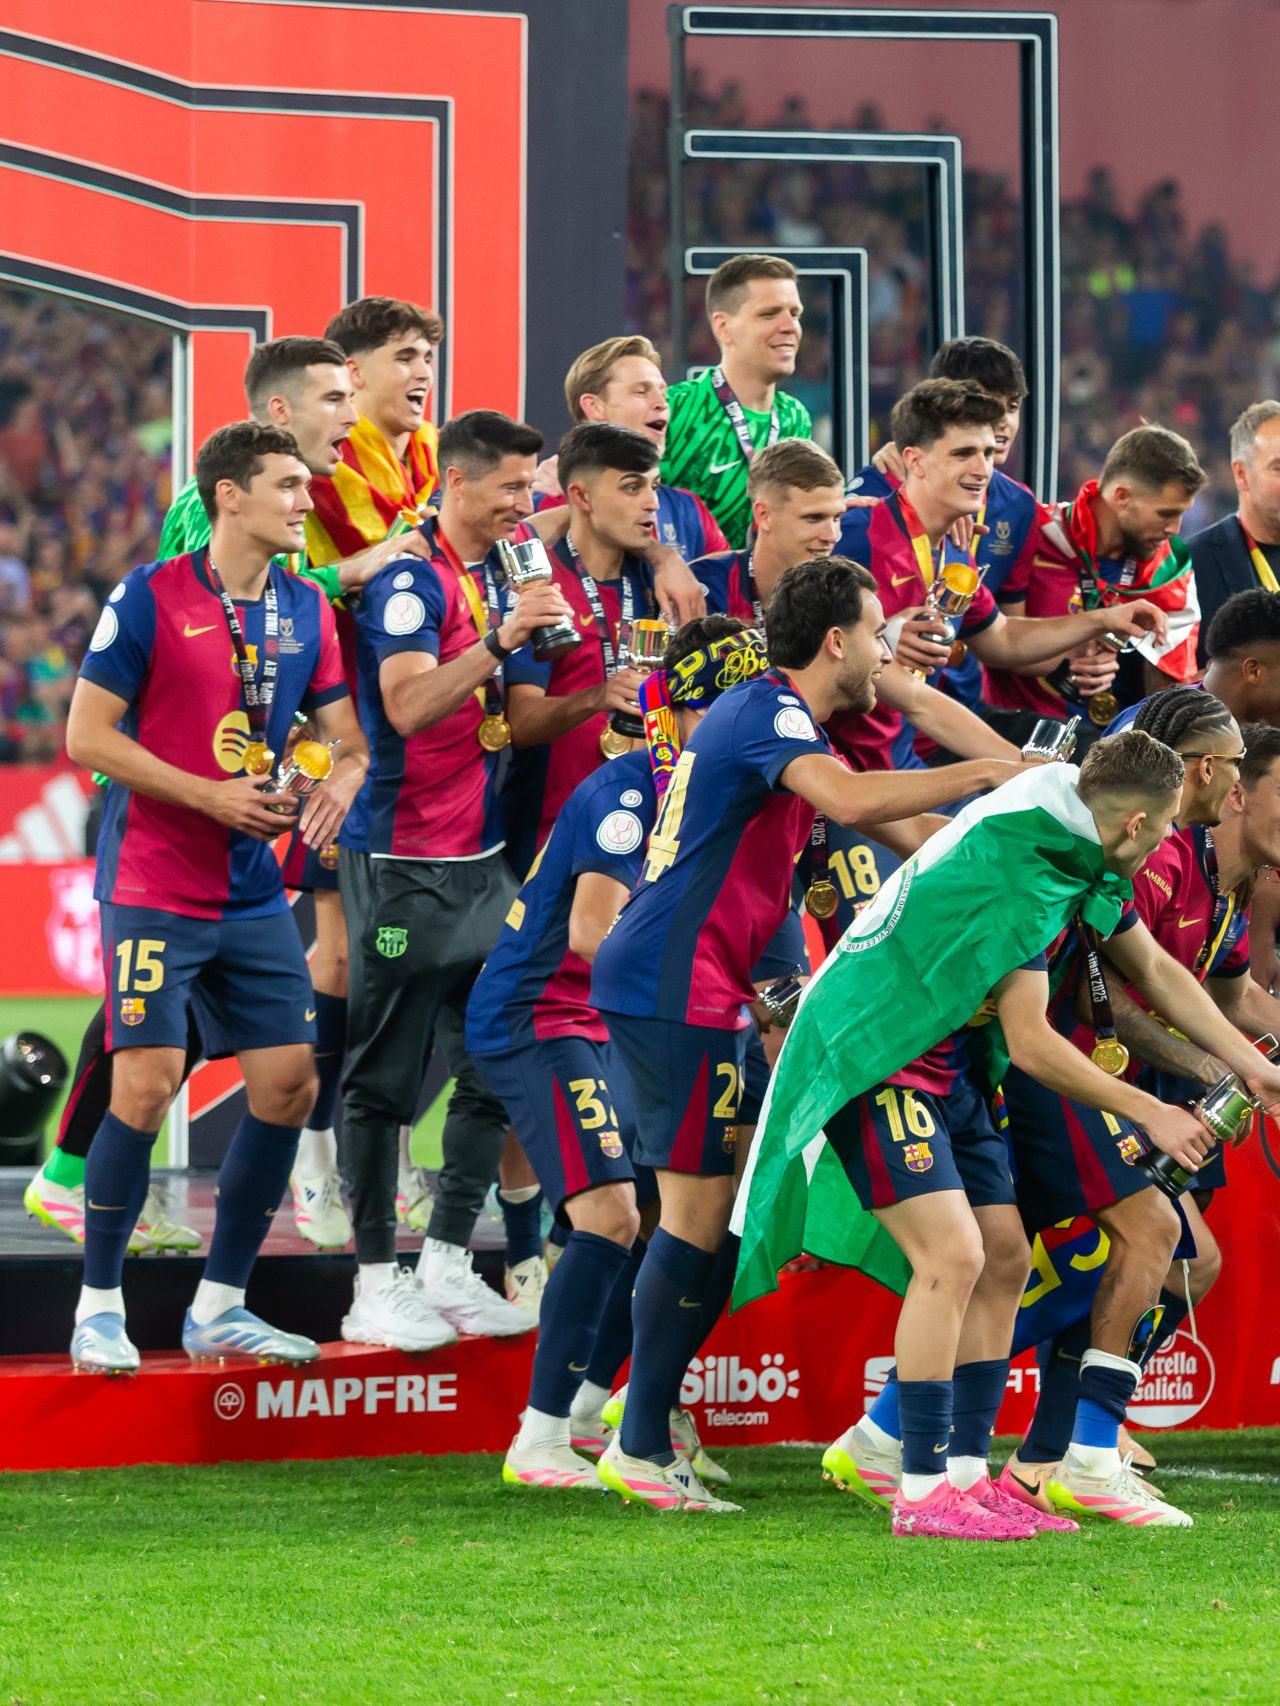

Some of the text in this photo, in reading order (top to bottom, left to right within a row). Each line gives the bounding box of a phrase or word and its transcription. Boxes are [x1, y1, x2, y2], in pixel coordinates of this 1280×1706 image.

[581, 576, 604, 618] COPA REY
[265, 612, 279, 636] FINAL
[263, 660, 278, 677] REY
[244, 685, 260, 706] 2025
[259, 682, 275, 705] COPA
[812, 822, 826, 846] 2025
[828, 844, 881, 900] 18
[1143, 868, 1173, 898] AMBILIG
[116, 938, 167, 993] 15
[1087, 951, 1109, 1003] FINAL 2025
[568, 1078, 618, 1130] 3
[712, 1062, 745, 1119] 2
[875, 1087, 936, 1142] 16
[256, 1373, 458, 1419] MAPFRE
[704, 1408, 769, 1427] Telecom
